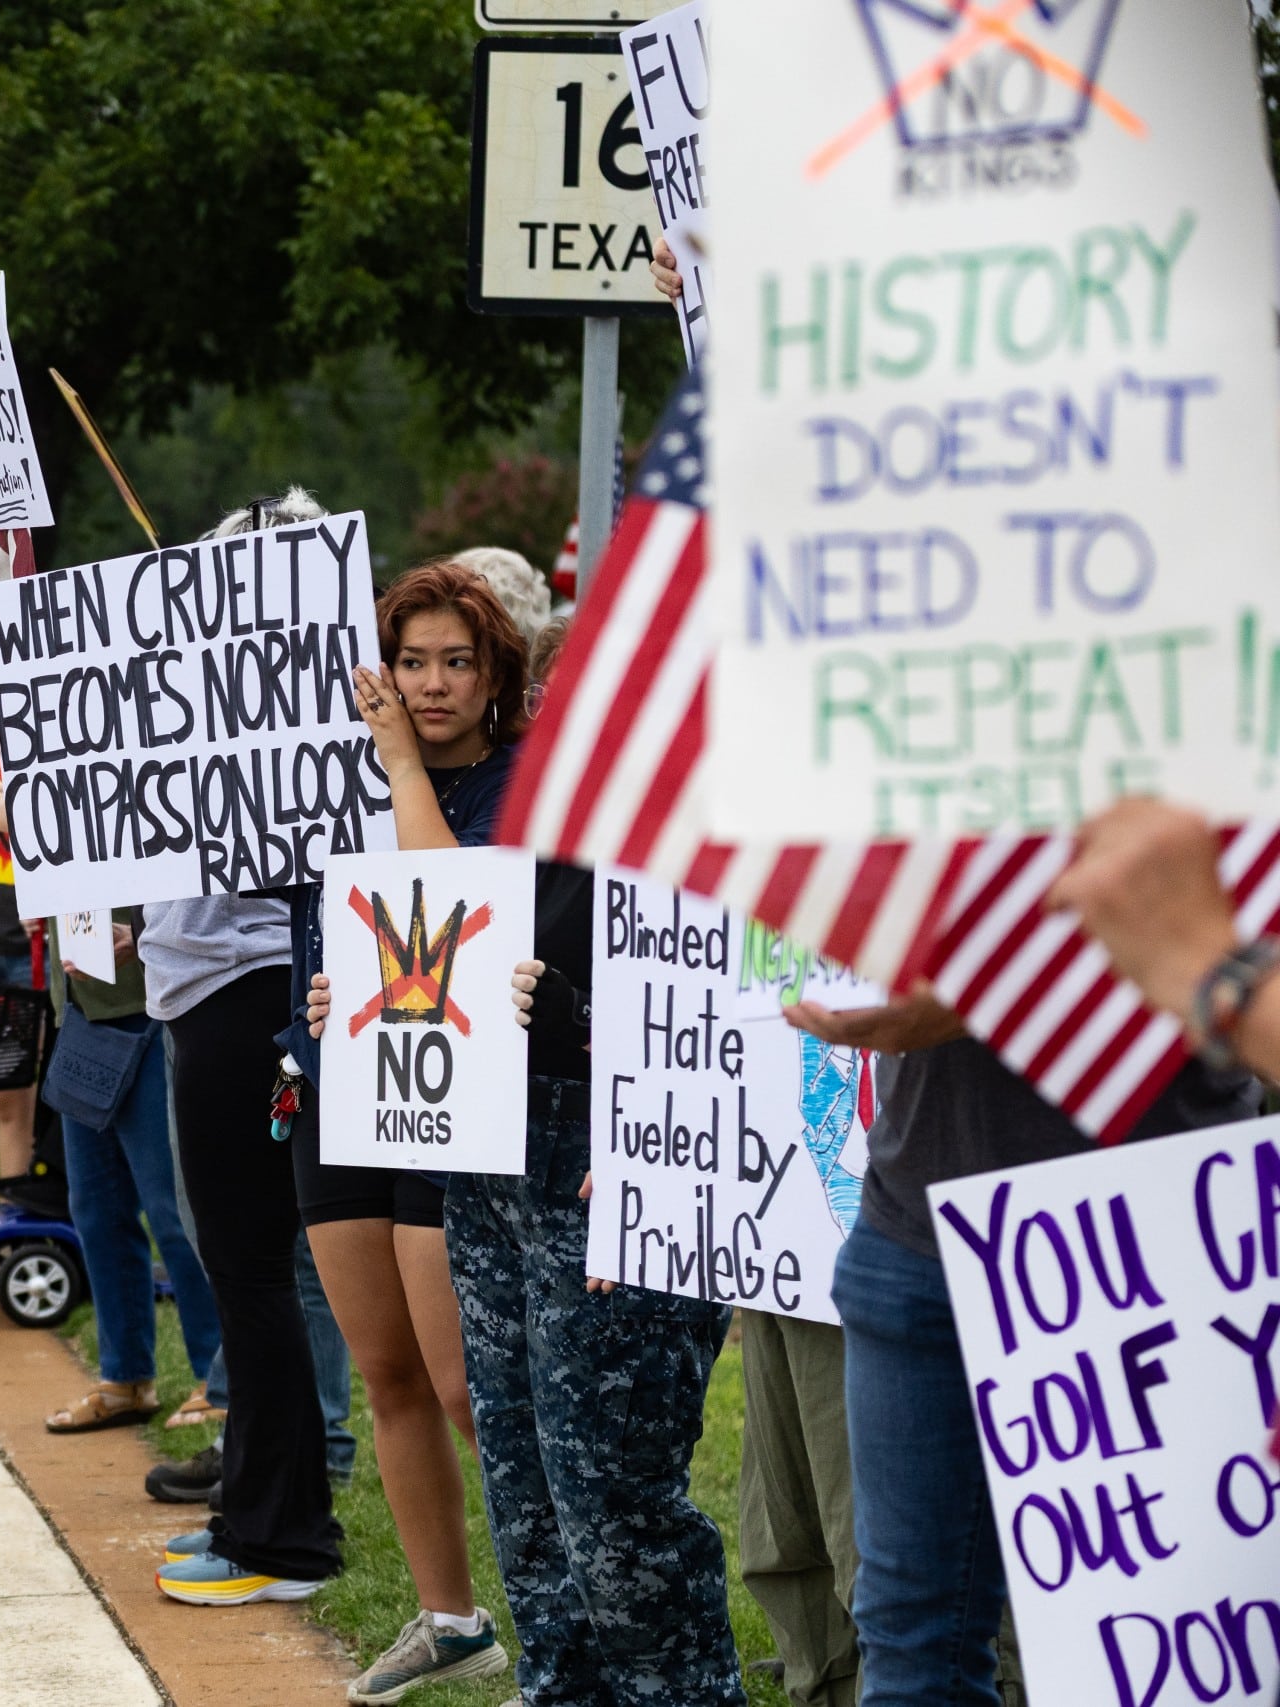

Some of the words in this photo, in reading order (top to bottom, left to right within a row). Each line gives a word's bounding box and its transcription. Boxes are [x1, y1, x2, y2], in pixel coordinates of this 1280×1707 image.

[556, 82, 651, 191] 16
[931, 48, 1047, 132] NO
[519, 222, 654, 272] TEXA
[756, 211, 1196, 393] HISTORY
[806, 370, 1218, 505] DOESN'T
[127, 520, 358, 650] CRUELTY
[746, 528, 978, 645] NEED
[1003, 512, 1157, 614] TO
[202, 622, 365, 742] NORMAL
[4, 755, 267, 871] COMPASSION
[272, 735, 392, 826] LOOKS
[607, 879, 730, 976] Blinded
[376, 1030, 454, 1105] NO
[644, 981, 745, 1080] Hate
[375, 1108, 453, 1145] KINGS
[611, 1074, 719, 1174] Fueled
[738, 1086, 798, 1219] by
[938, 1181, 1166, 1356] YOU
[976, 1320, 1179, 1479] GOLF
